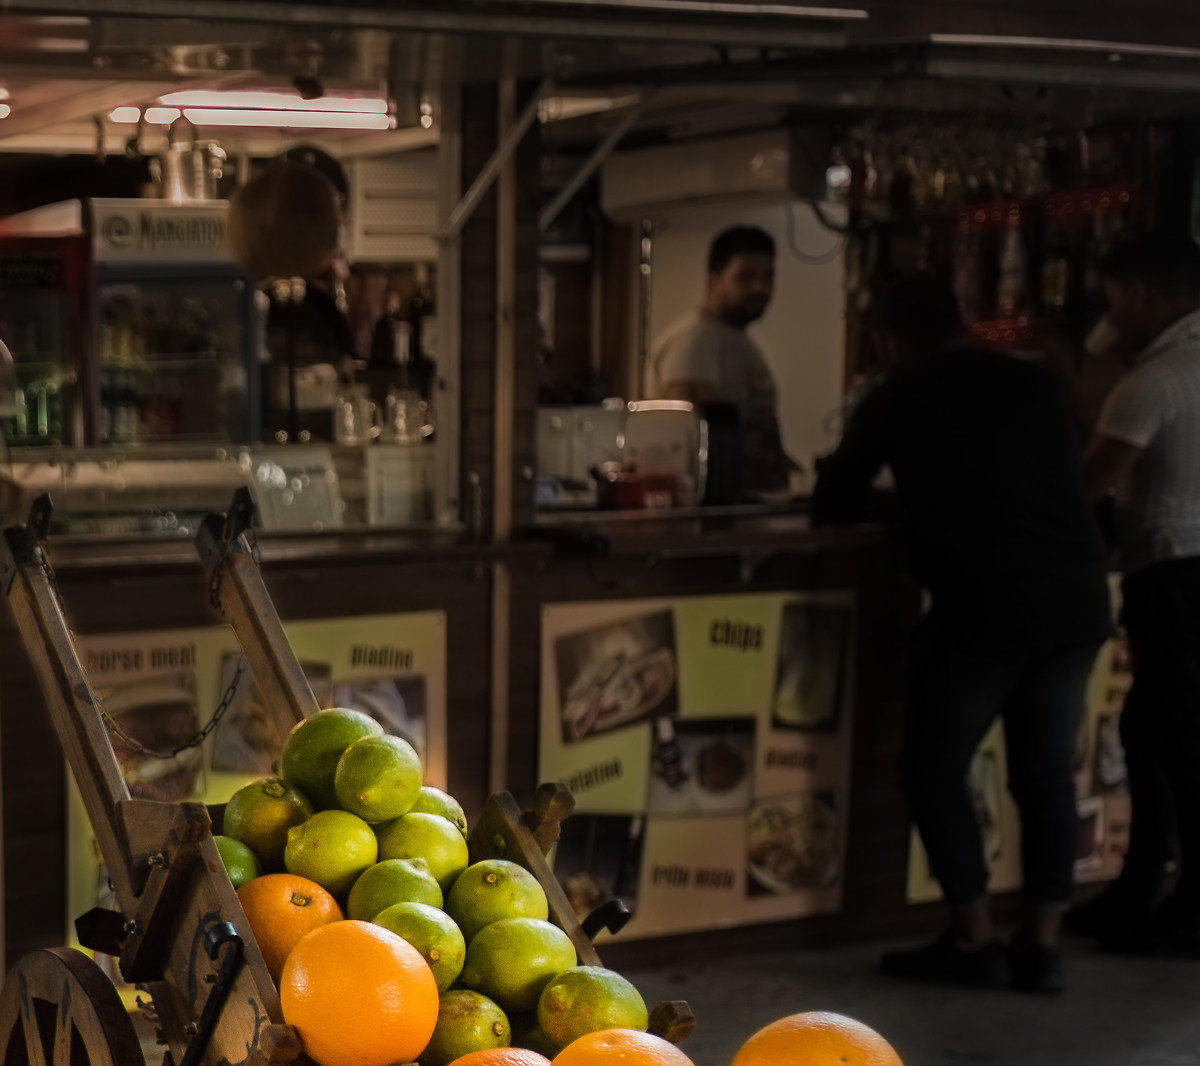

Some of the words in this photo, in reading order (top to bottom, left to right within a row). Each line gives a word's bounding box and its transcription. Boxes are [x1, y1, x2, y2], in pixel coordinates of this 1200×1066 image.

[709, 618, 765, 652] chips
[150, 643, 196, 670] meat
[350, 643, 415, 670] piadine
